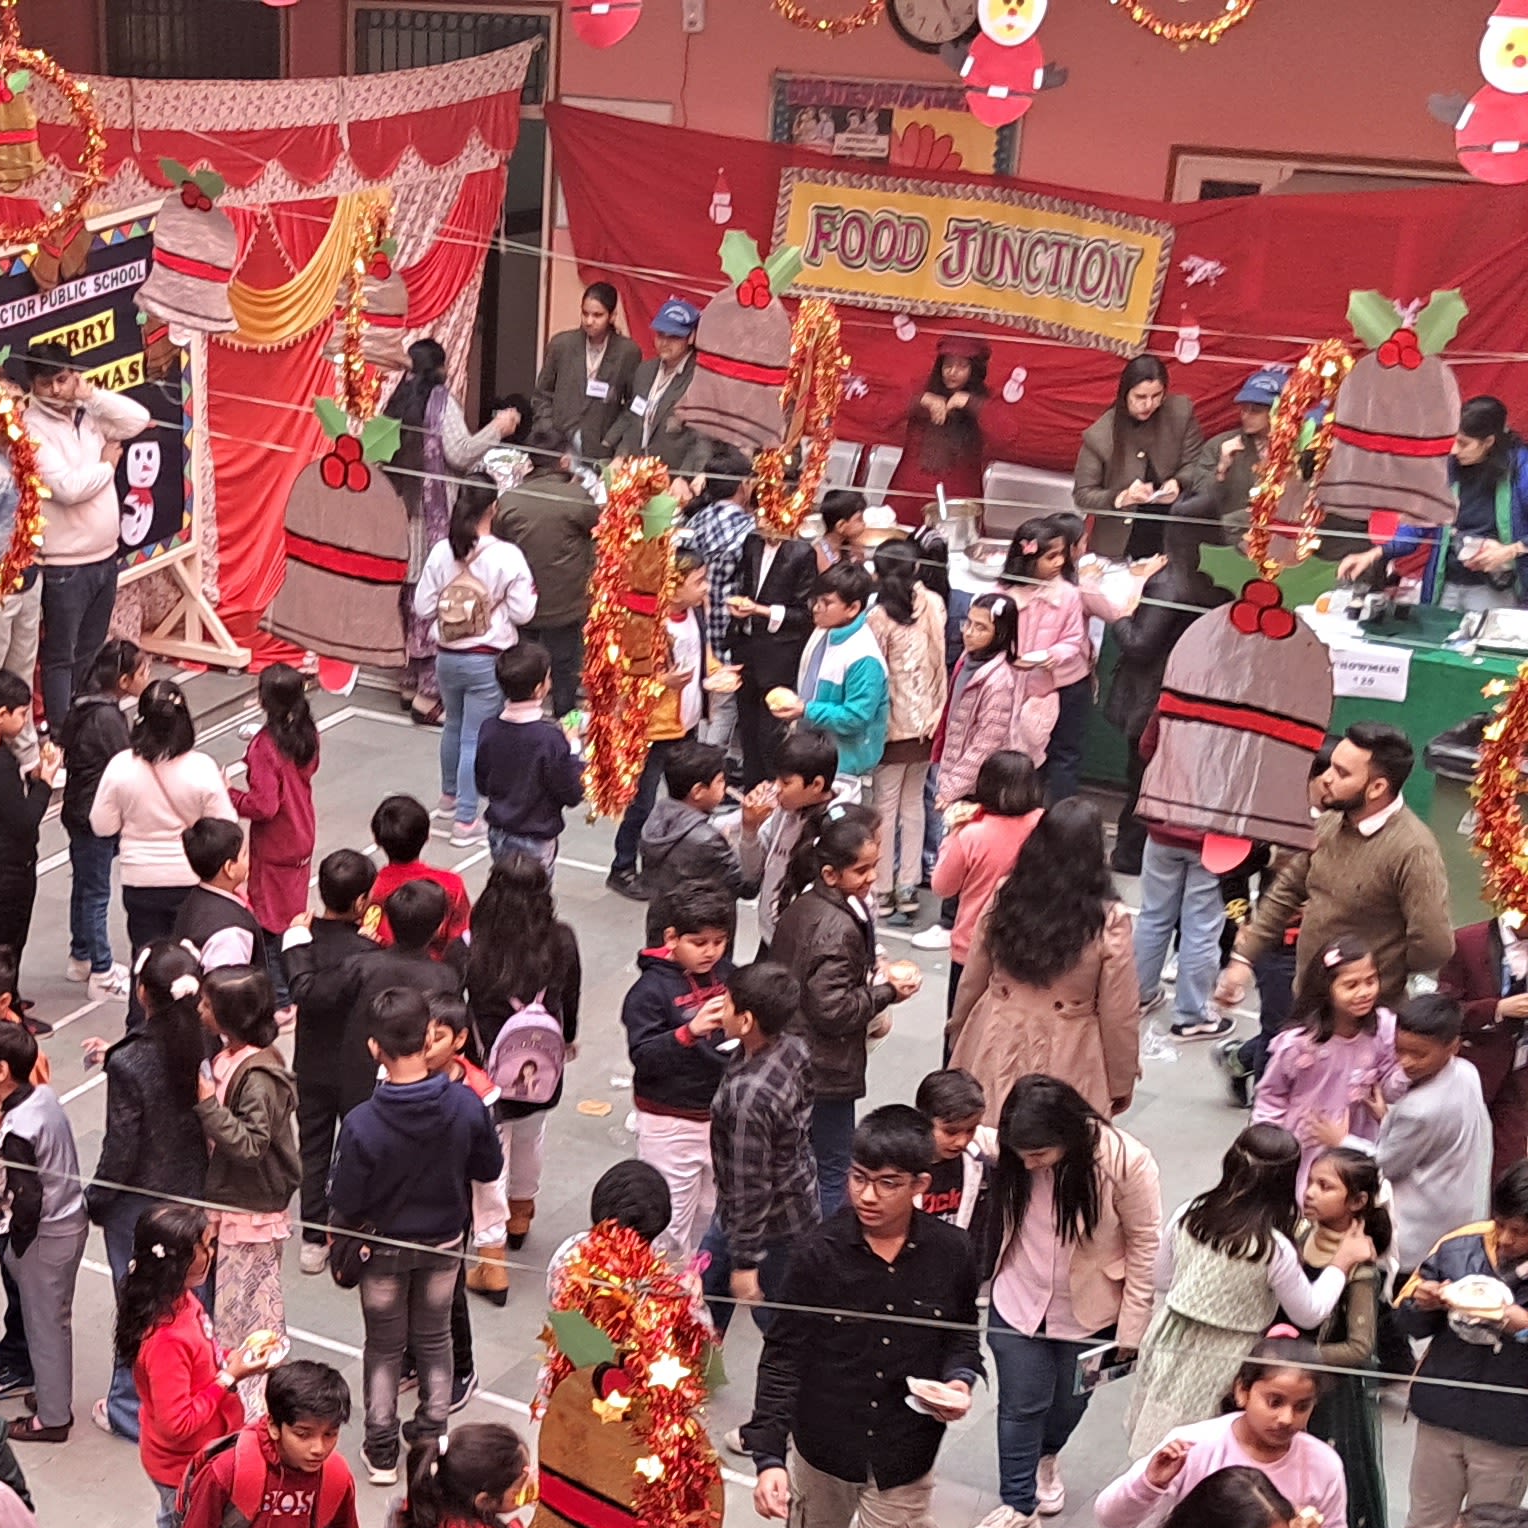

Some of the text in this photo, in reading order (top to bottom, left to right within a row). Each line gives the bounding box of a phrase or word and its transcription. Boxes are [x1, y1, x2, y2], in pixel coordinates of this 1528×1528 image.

[803, 205, 1144, 311] FOOD JUNCTION
[40, 281, 88, 312] PUBLIC
[93, 262, 144, 293] SCHOOL
[86, 360, 141, 390] MAS
